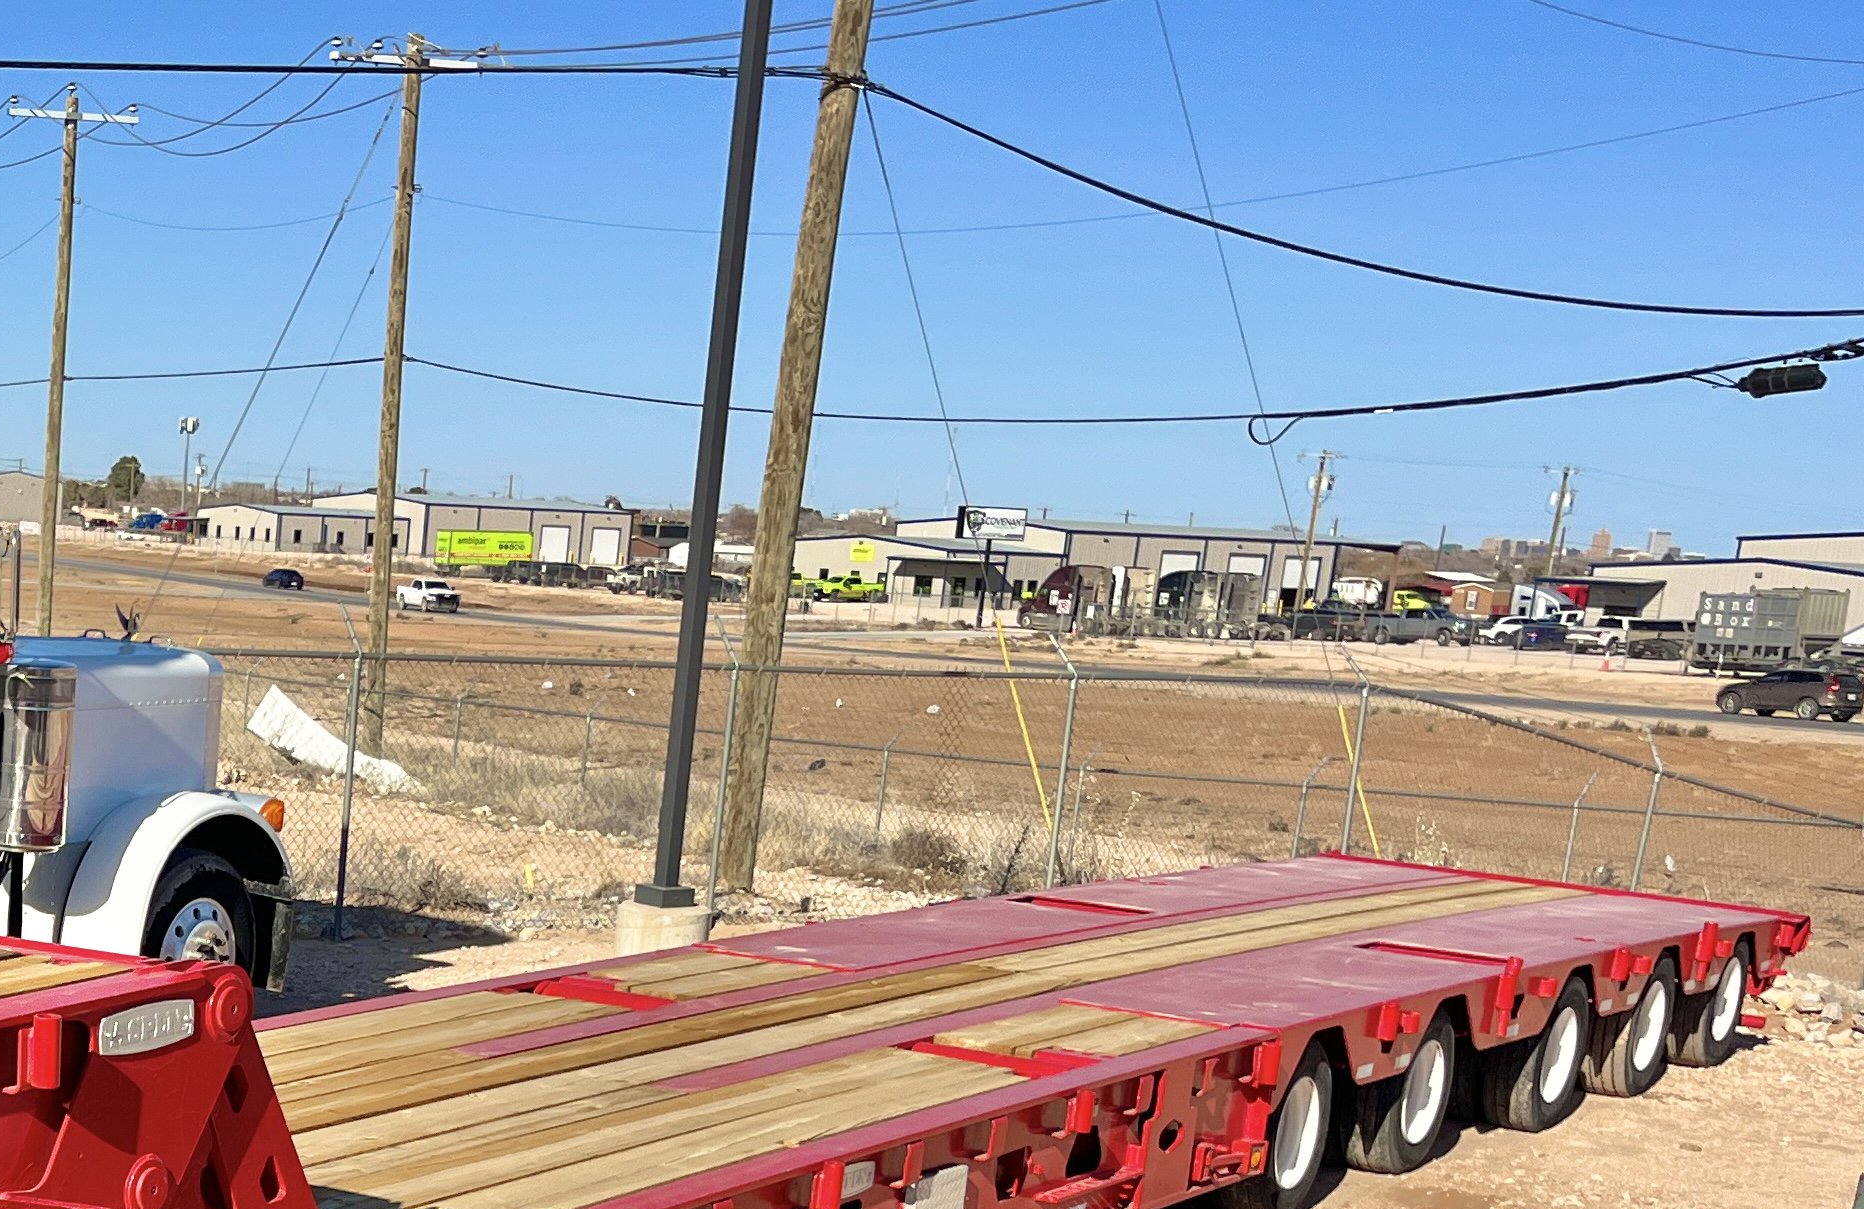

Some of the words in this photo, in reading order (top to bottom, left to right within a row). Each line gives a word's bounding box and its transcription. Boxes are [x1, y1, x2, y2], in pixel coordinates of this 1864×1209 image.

[985, 517, 1025, 526] COVENANT
[457, 537, 486, 545] ambipar
[1704, 598, 1754, 611] Sand
